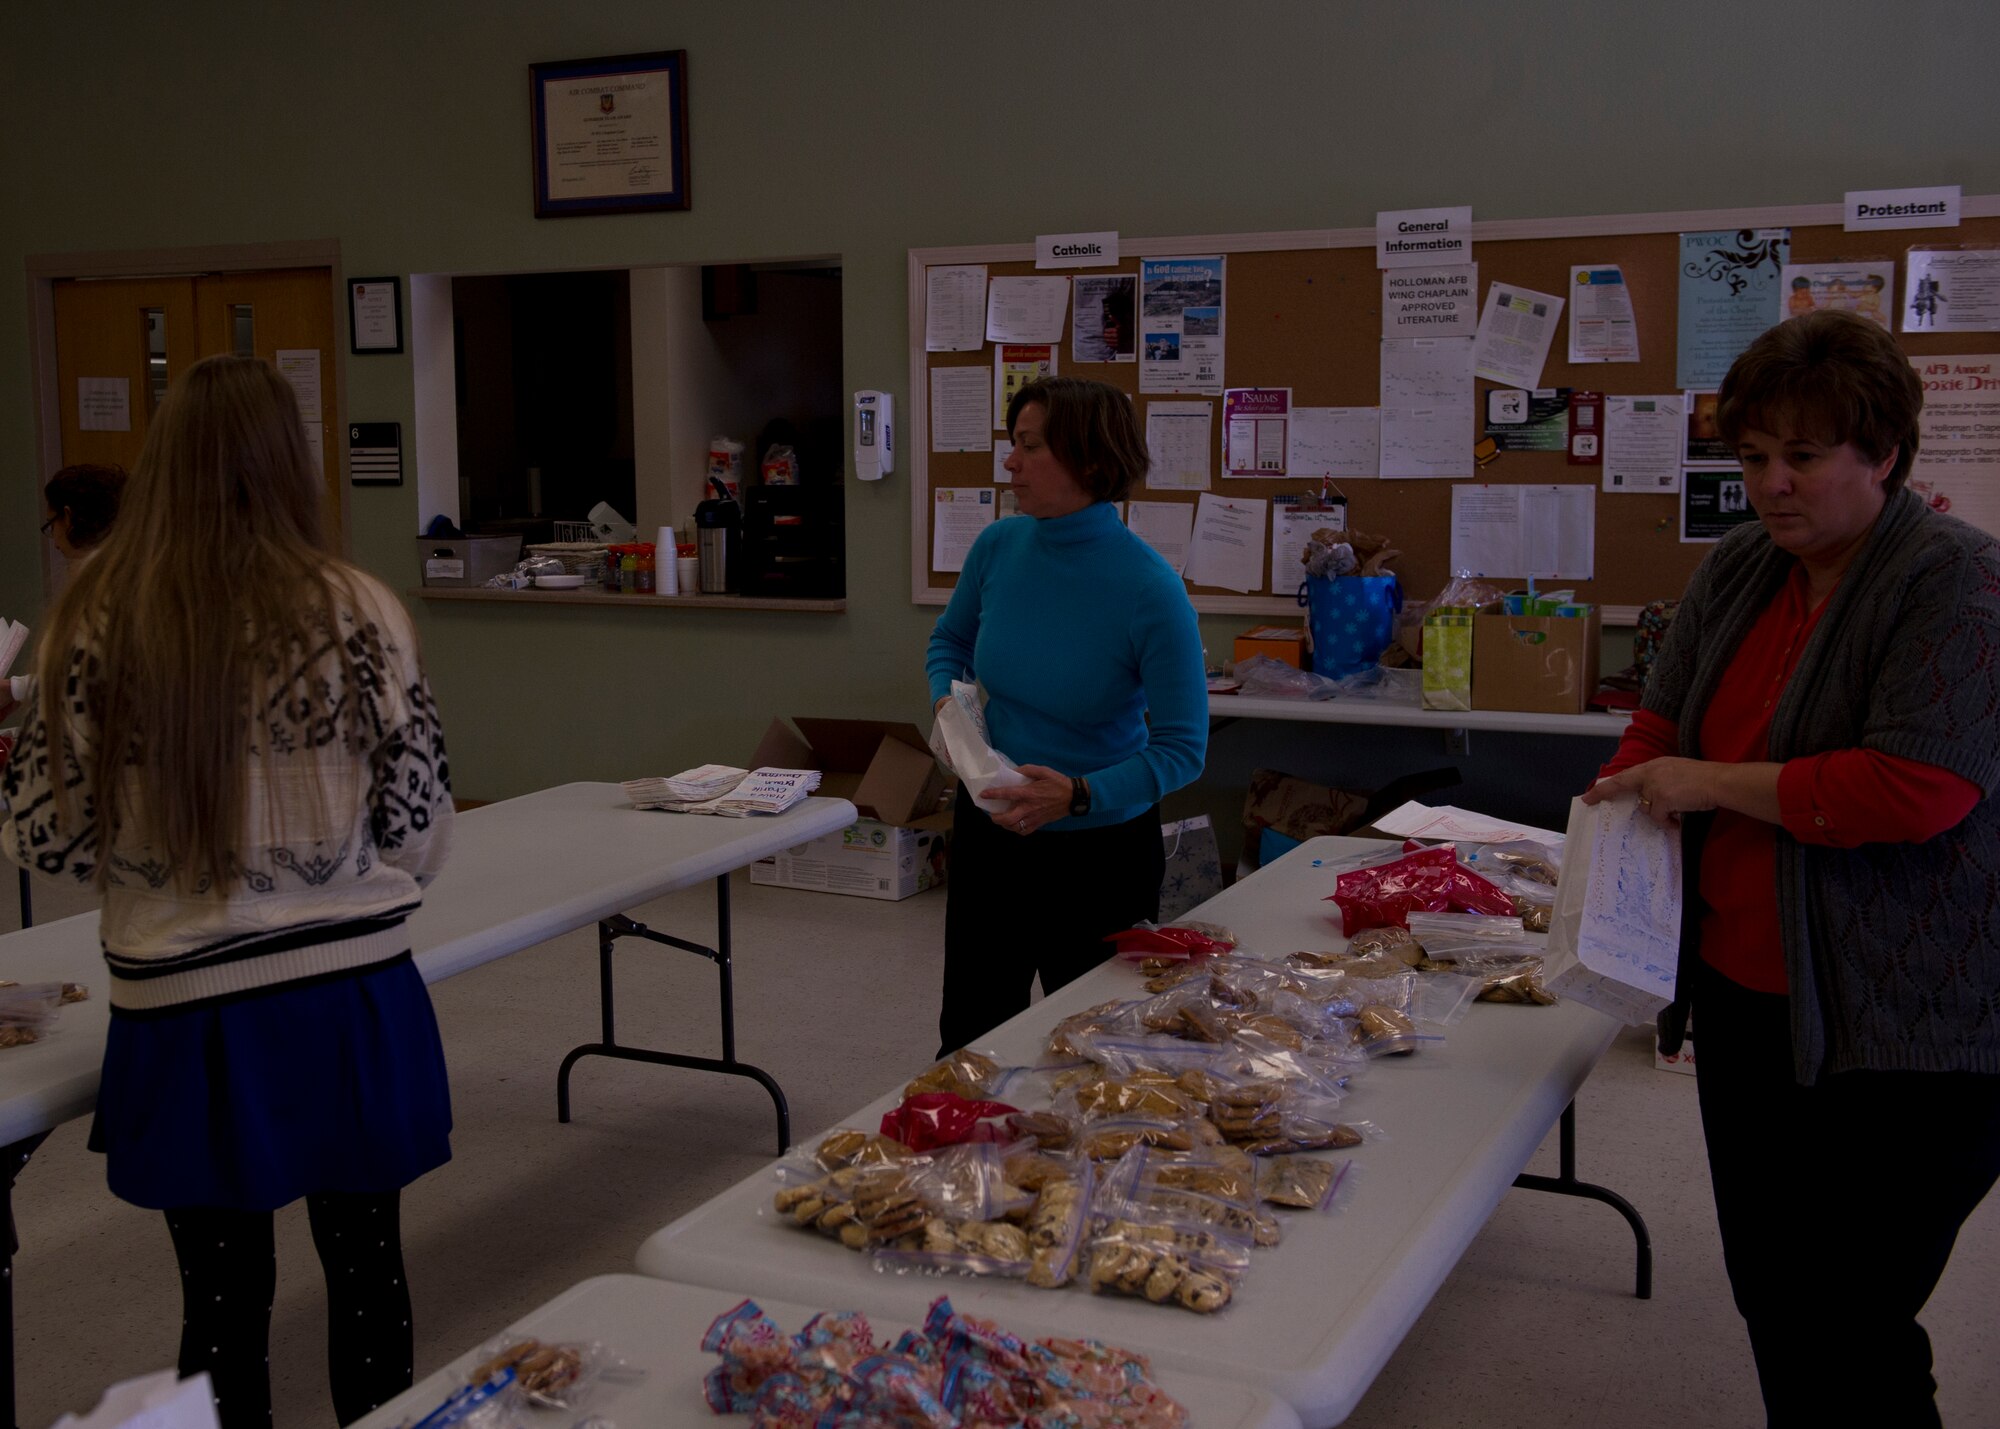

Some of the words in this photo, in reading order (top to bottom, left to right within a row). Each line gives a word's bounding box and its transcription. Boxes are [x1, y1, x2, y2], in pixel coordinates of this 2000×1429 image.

[1857, 200, 1947, 217] Protestant
[1397, 219, 1449, 233] General
[1385, 237, 1463, 253] Information
[1686, 235, 1728, 248] PWOC
[1052, 243, 1102, 257] Catholic
[1153, 264, 1170, 274] God
[1389, 276, 1446, 287] HOLLOMAN
[1447, 275, 1468, 285] AFB
[1388, 289, 1416, 300] WING
[1417, 287, 1469, 299] CHAPLAIN
[1400, 301, 1456, 312] APPROVED
[1397, 314, 1460, 325] LITERATURE
[1921, 379, 1964, 391] ookie
[1241, 392, 1279, 404] PSALMS
[351, 427, 360, 440] 6
[764, 779, 795, 787] Brown
